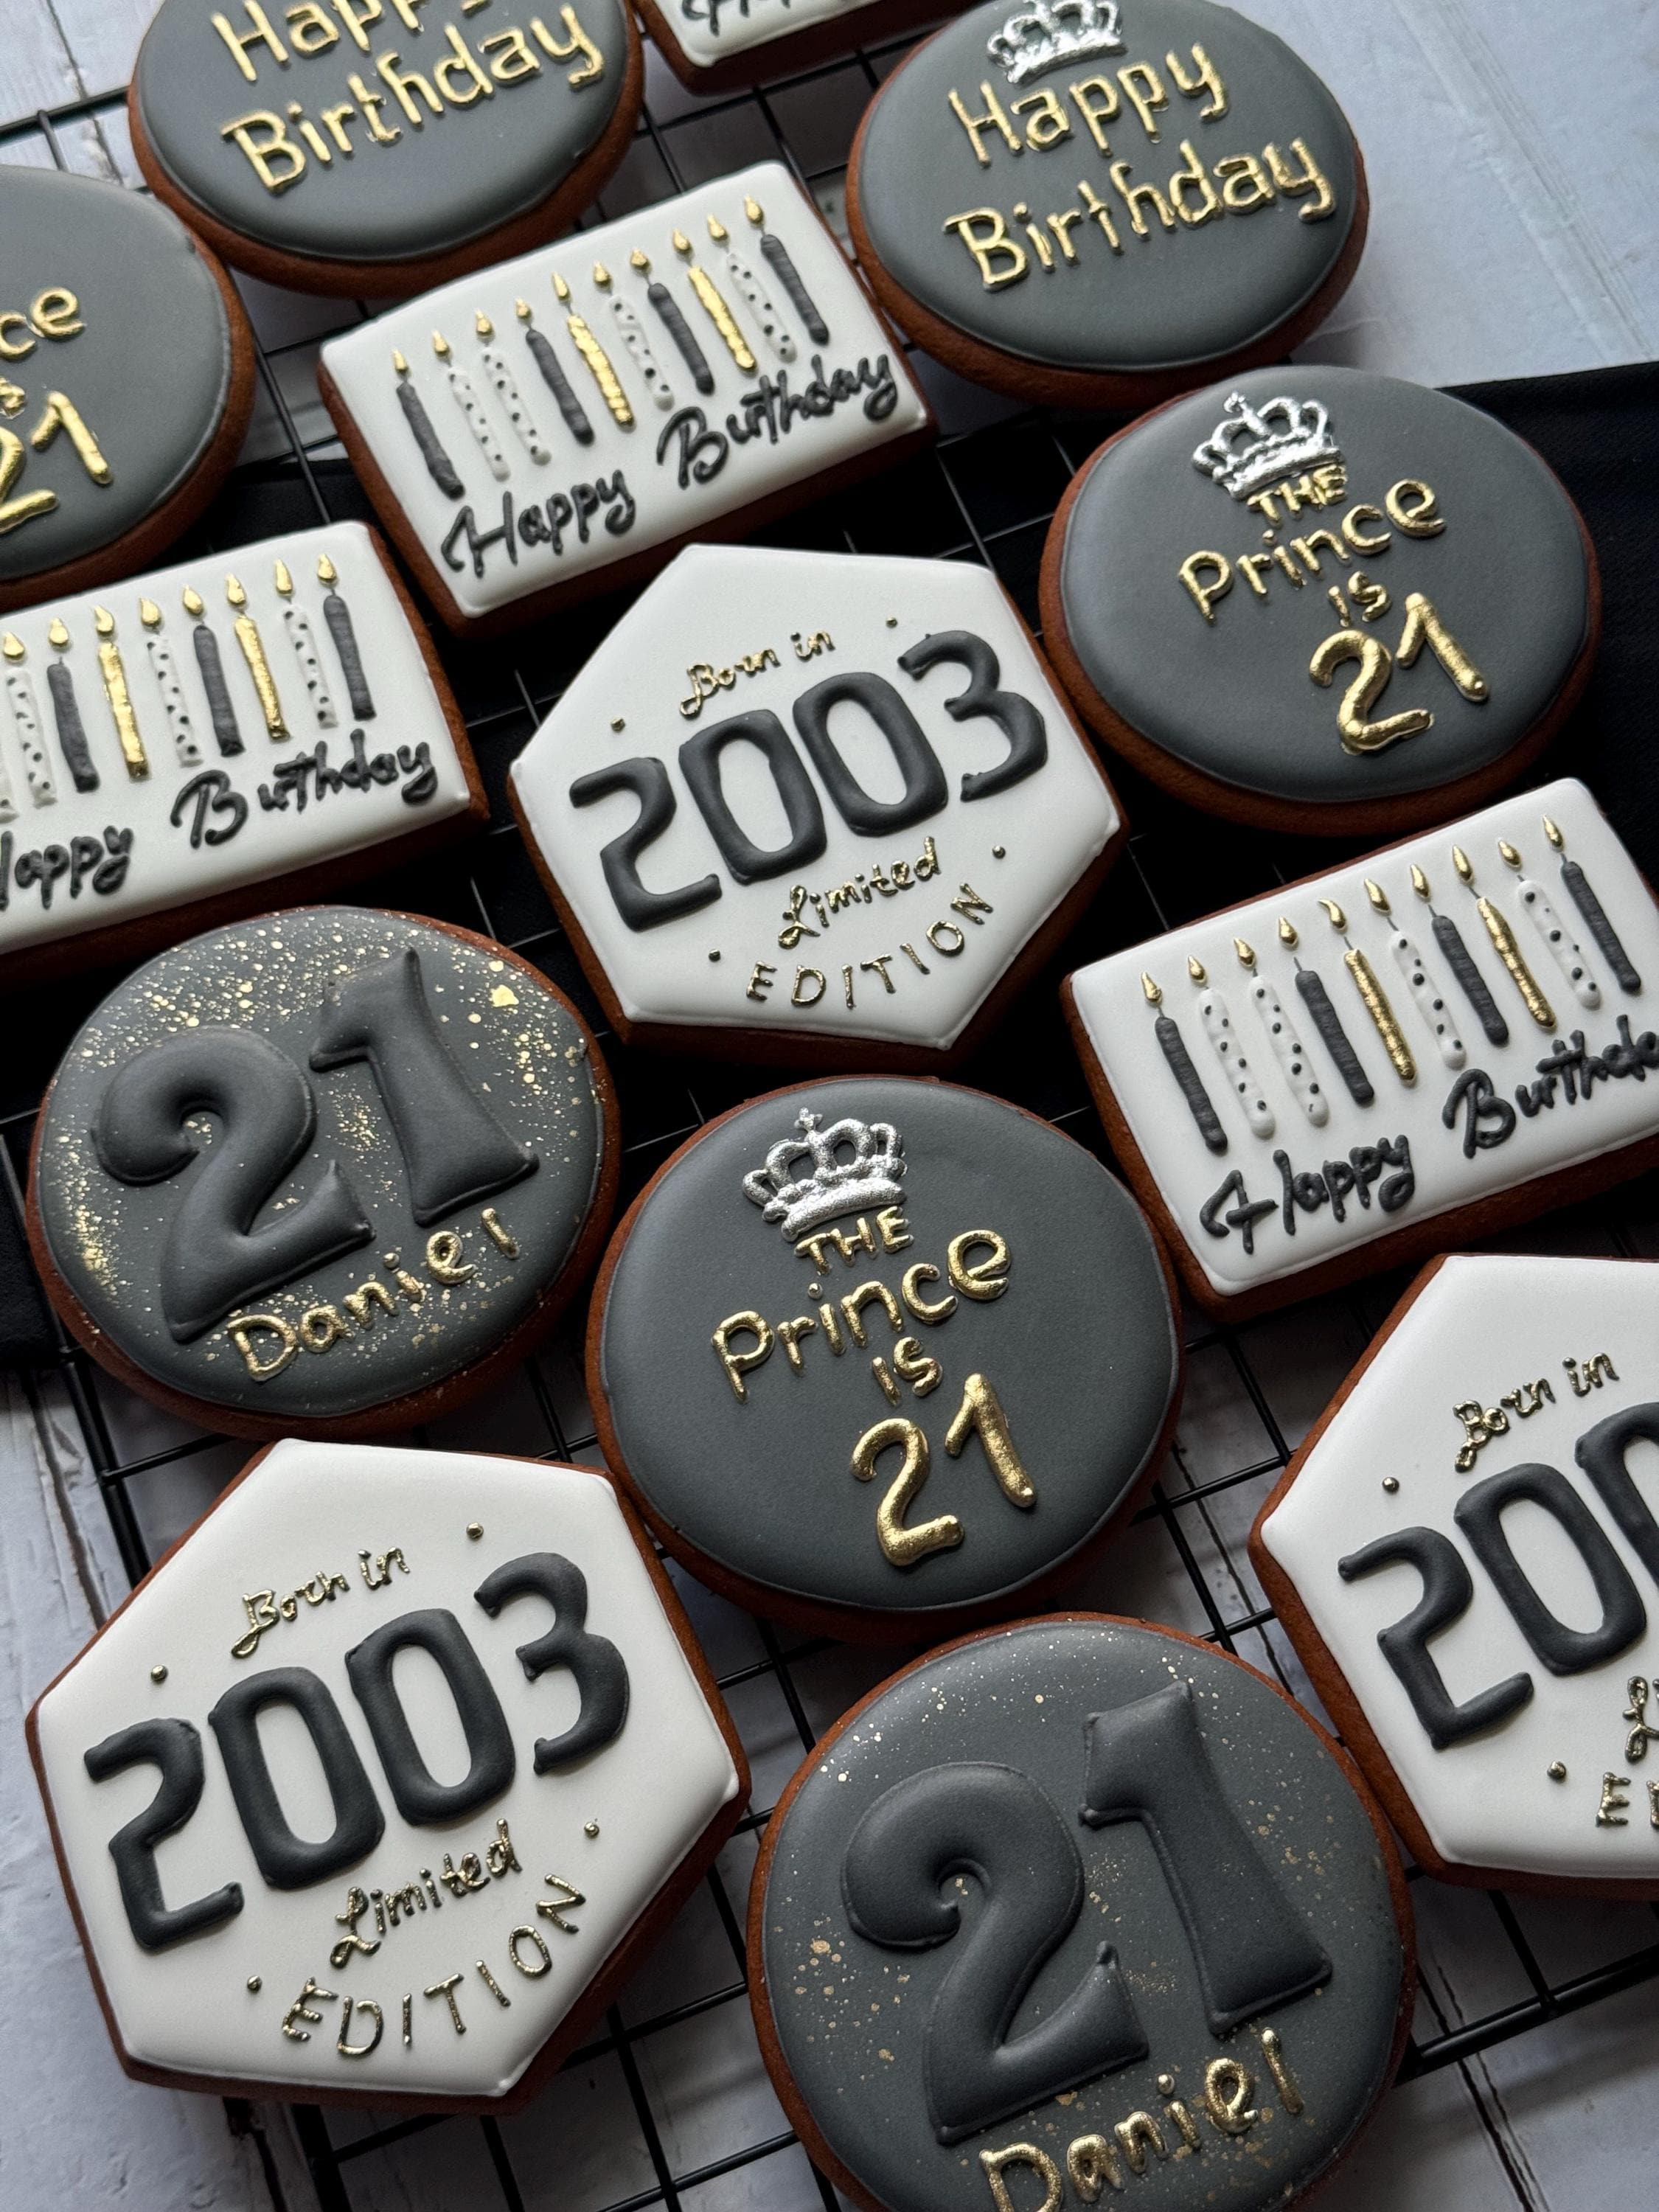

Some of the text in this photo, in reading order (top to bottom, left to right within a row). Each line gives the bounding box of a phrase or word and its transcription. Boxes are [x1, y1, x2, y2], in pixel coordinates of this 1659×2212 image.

[221, 4, 605, 193] Birthday
[947, 42, 1230, 167] Happy
[942, 138, 1335, 292] Birthday
[441, 354, 899, 579] Happy Birthday
[1247, 465, 1348, 529] THE
[1179, 479, 1447, 625] Prince
[679, 629, 836, 718] Born in
[1309, 592, 1489, 756] 21
[170, 728, 438, 850] Birthday
[569, 630, 1048, 933] 2003
[745, 883, 994, 1010] EDITION
[777, 837, 940, 950] Limited
[90, 947, 540, 1345] 21
[1200, 1134, 1416, 1254] Happy
[226, 1206, 520, 1382] Daniel
[711, 1229, 1012, 1404] Prince
[794, 1206, 915, 1275] THE
[850, 1372, 1037, 1568] 21
[1453, 1352, 1620, 1473] Born in
[231, 1546, 411, 1658] Born in
[83, 1551, 631, 1956] 2003
[282, 1874, 587, 2059] EDITION
[330, 1818, 523, 1968] Limited
[840, 1680, 1332, 2146] 21
[978, 2027, 1304, 2212] Daniel
